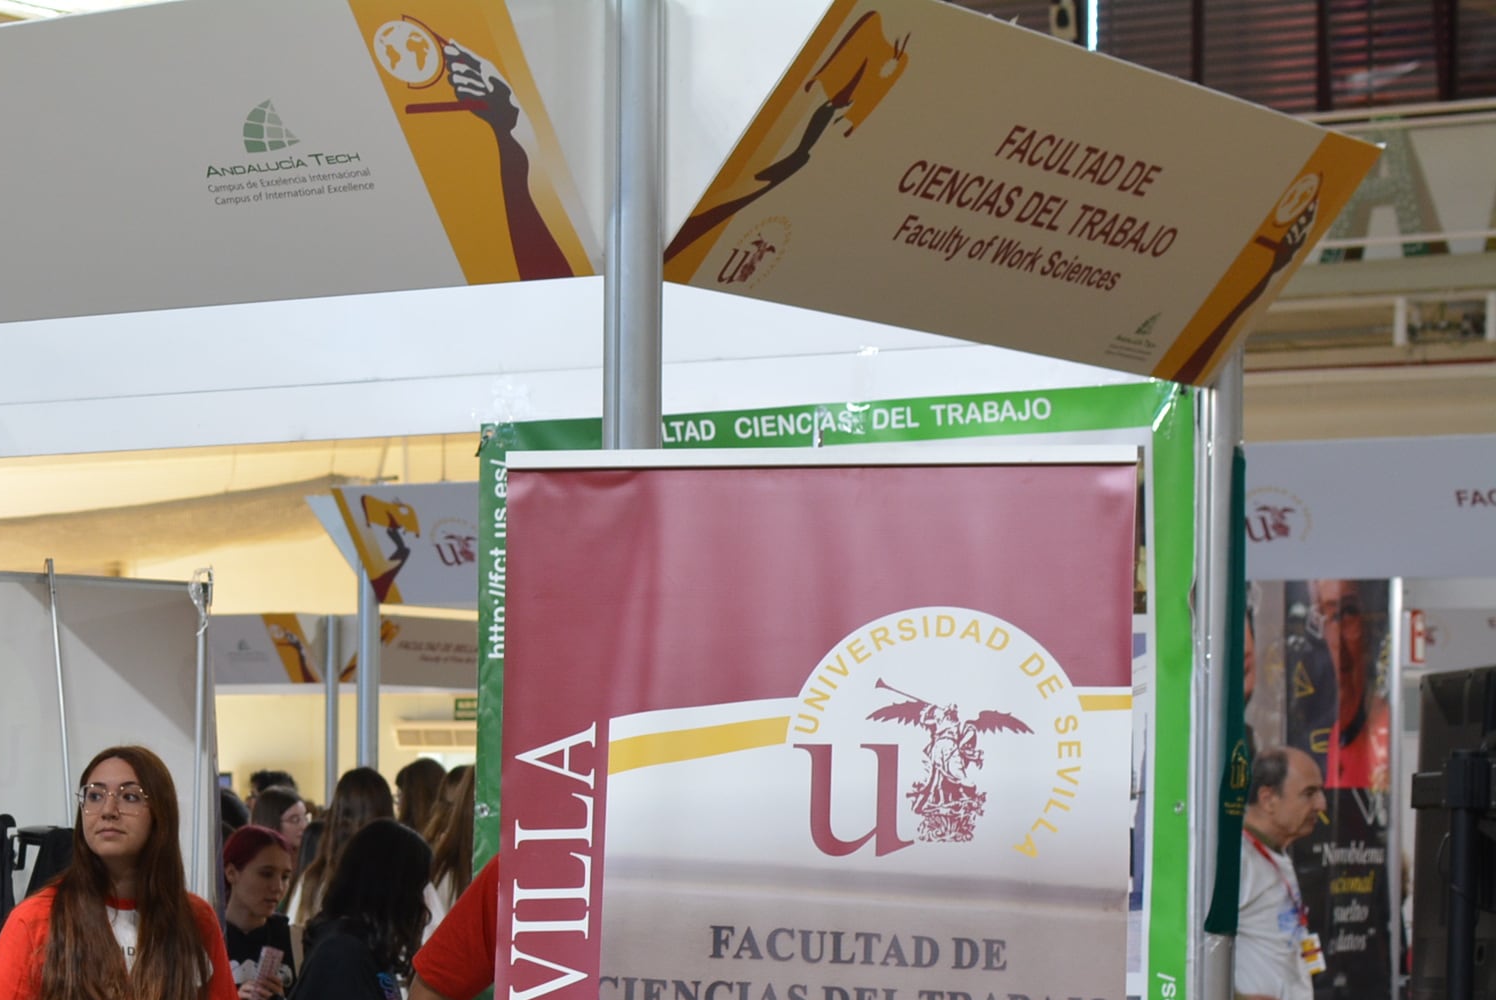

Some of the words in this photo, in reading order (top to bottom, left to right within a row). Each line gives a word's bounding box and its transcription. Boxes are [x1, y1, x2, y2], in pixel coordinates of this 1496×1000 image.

[208, 182, 244, 193] Campus
[246, 180, 258, 189] de
[259, 175, 308, 188] Excelencia
[309, 168, 371, 182] Internacional
[214, 194, 251, 206] Campus
[252, 193, 263, 202] of
[265, 187, 325, 200] International
[327, 181, 375, 194] Excellence
[994, 124, 1125, 186] FACULTAD
[1117, 160, 1163, 198] DE
[898, 159, 1024, 219] CIENCIAS
[1015, 191, 1069, 232] DEL
[1068, 204, 1178, 258] TRABAJO
[893, 214, 970, 262] Faculty
[967, 235, 999, 260] of
[990, 237, 1043, 273] Work
[1040, 250, 1122, 292] Sciences
[662, 419, 716, 442] LTAD
[872, 405, 920, 430] DEL
[930, 396, 1052, 428] TRABAJO
[488, 457, 507, 660] http://fctuses/
[794, 614, 1010, 734] UNIVERSIDAD
[1019, 652, 1064, 700] DE
[1012, 715, 1082, 858] SEVILLA
[709, 925, 940, 969] FACULTAD
[951, 937, 1008, 972] DE
